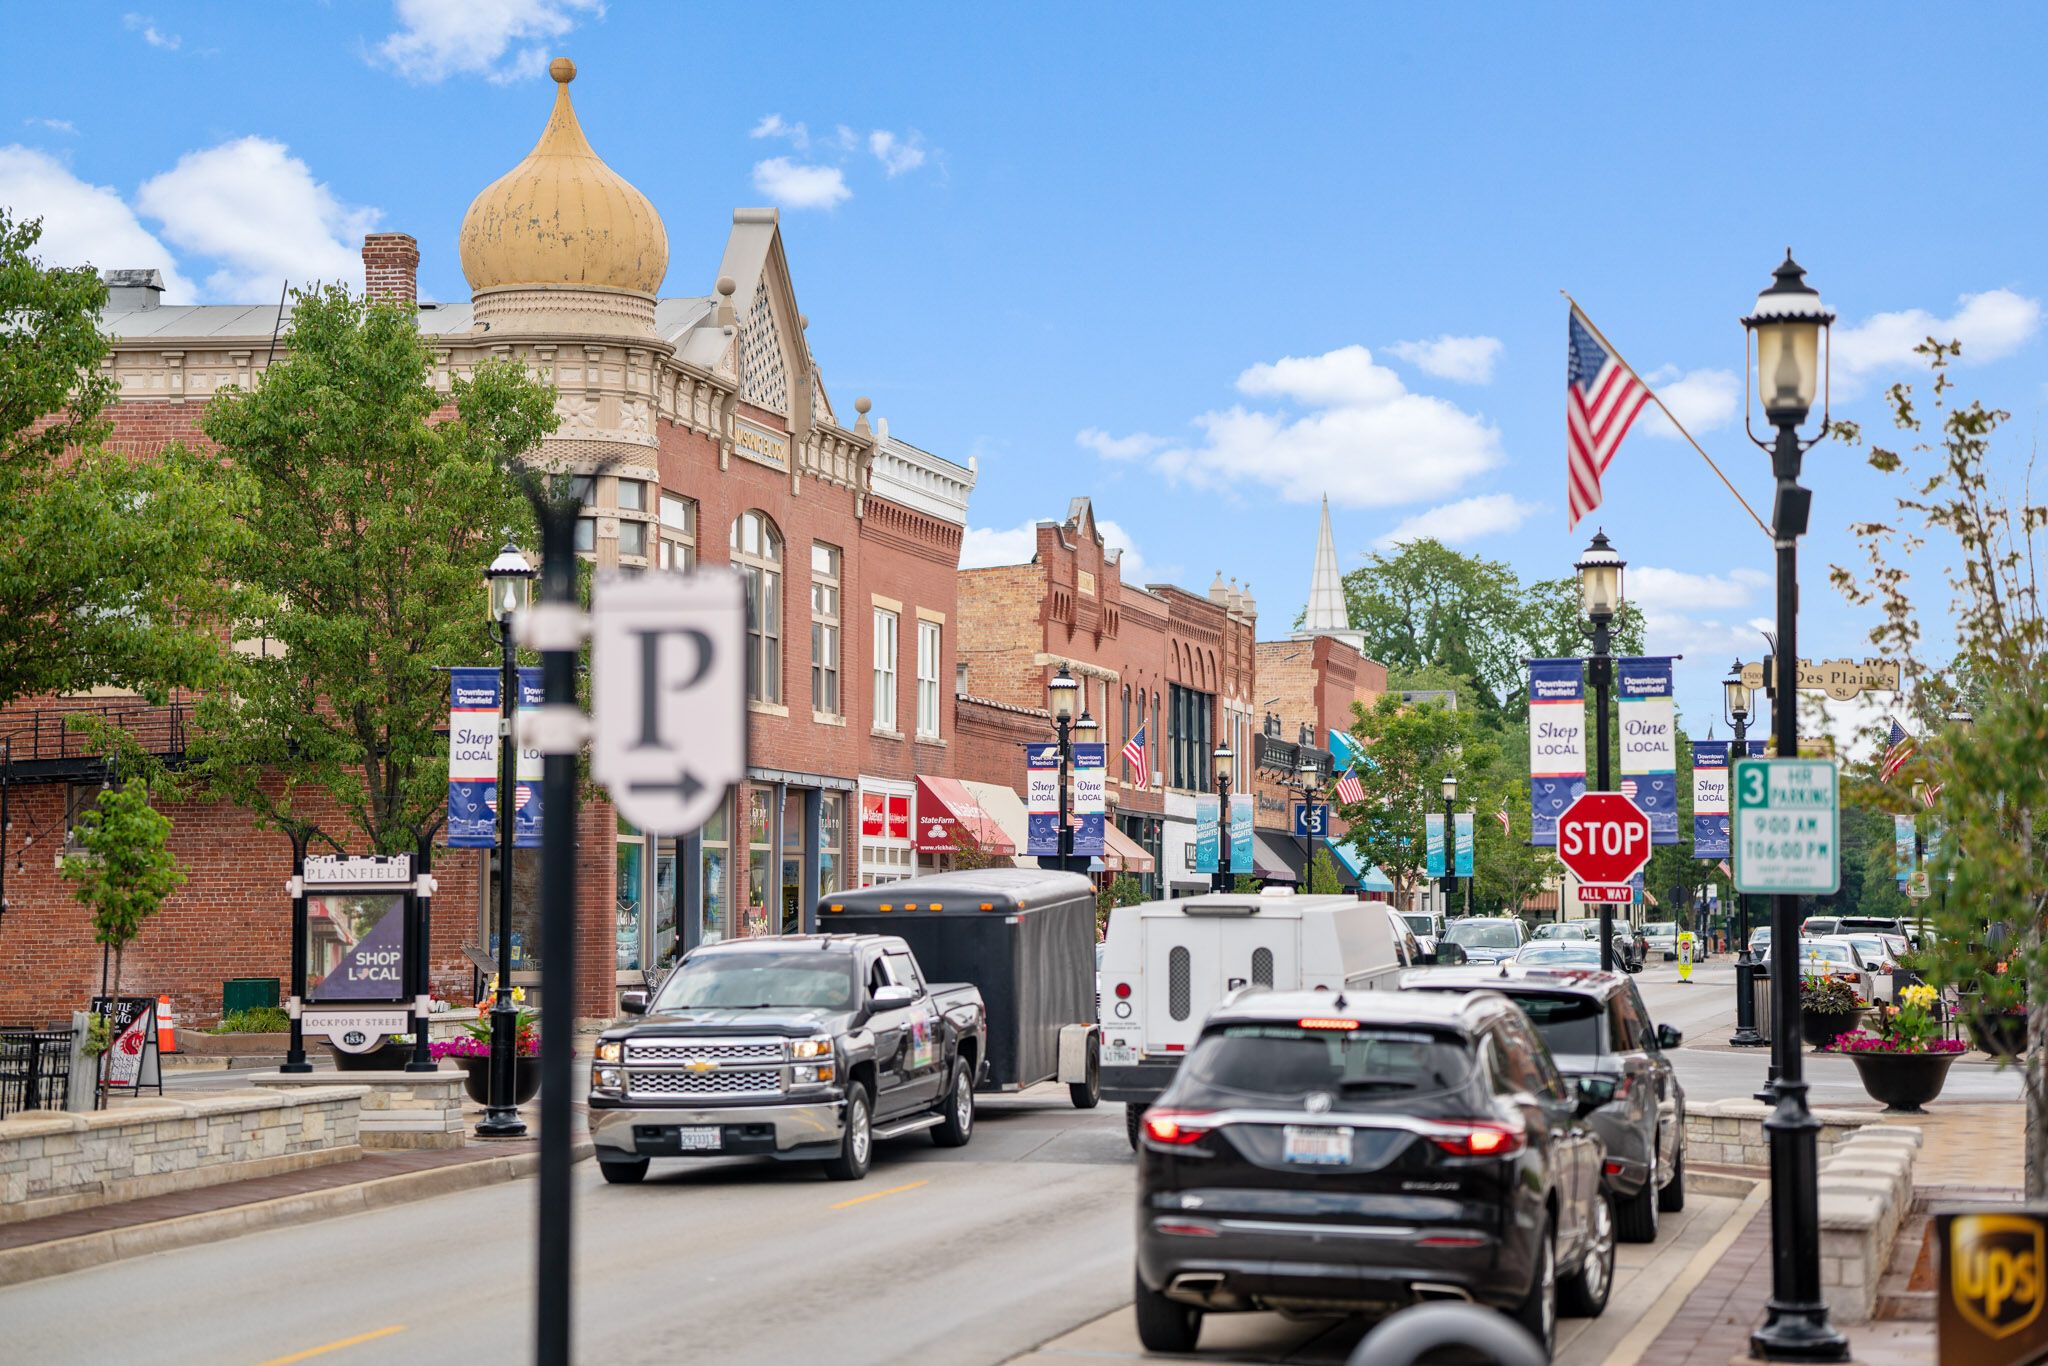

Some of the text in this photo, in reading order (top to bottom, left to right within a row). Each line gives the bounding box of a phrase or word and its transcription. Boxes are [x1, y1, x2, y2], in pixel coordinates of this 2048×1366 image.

[1624, 677, 1667, 686] Downtown
[1831, 671, 1895, 685] Plaines
[627, 627, 715, 751] P
[1535, 680, 1578, 688] Downtown
[1627, 685, 1665, 694] Plainfield
[456, 688, 495, 696] Downtown
[1538, 688, 1576, 697] Plainfield
[1835, 687, 1849, 697] St.
[459, 696, 493, 704] Plainfield
[1537, 722, 1578, 743] Shop
[1625, 719, 1668, 736] Dine
[456, 729, 494, 751] Shop
[1537, 744, 1579, 755] LOCAL
[1626, 742, 1669, 752] LOCAL
[455, 750, 494, 761] LOCAL
[1031, 780, 1056, 794] Shop
[1077, 780, 1102, 791] Dine
[1698, 780, 1725, 795] Shop
[1742, 767, 1766, 805] 3
[1031, 794, 1056, 802] LOCAL
[1697, 794, 1725, 802] LOCAL
[1771, 787, 1830, 806] PARKING
[1198, 821, 1217, 830] CRUISE
[1231, 820, 1252, 831] CRUISE
[1796, 817, 1818, 834] AM
[1197, 828, 1218, 839] NIGHTS
[1231, 828, 1252, 839] NIGHTS
[1563, 821, 1645, 856] STOP
[307, 867, 408, 880] PLAINFIELD
[1580, 888, 1629, 900] ALL WAY
[355, 952, 401, 966] SHOP
[305, 1018, 404, 1027] LOCKPORT STREET
[344, 1033, 366, 1045] 1834
[1957, 1248, 2036, 1319] ups
